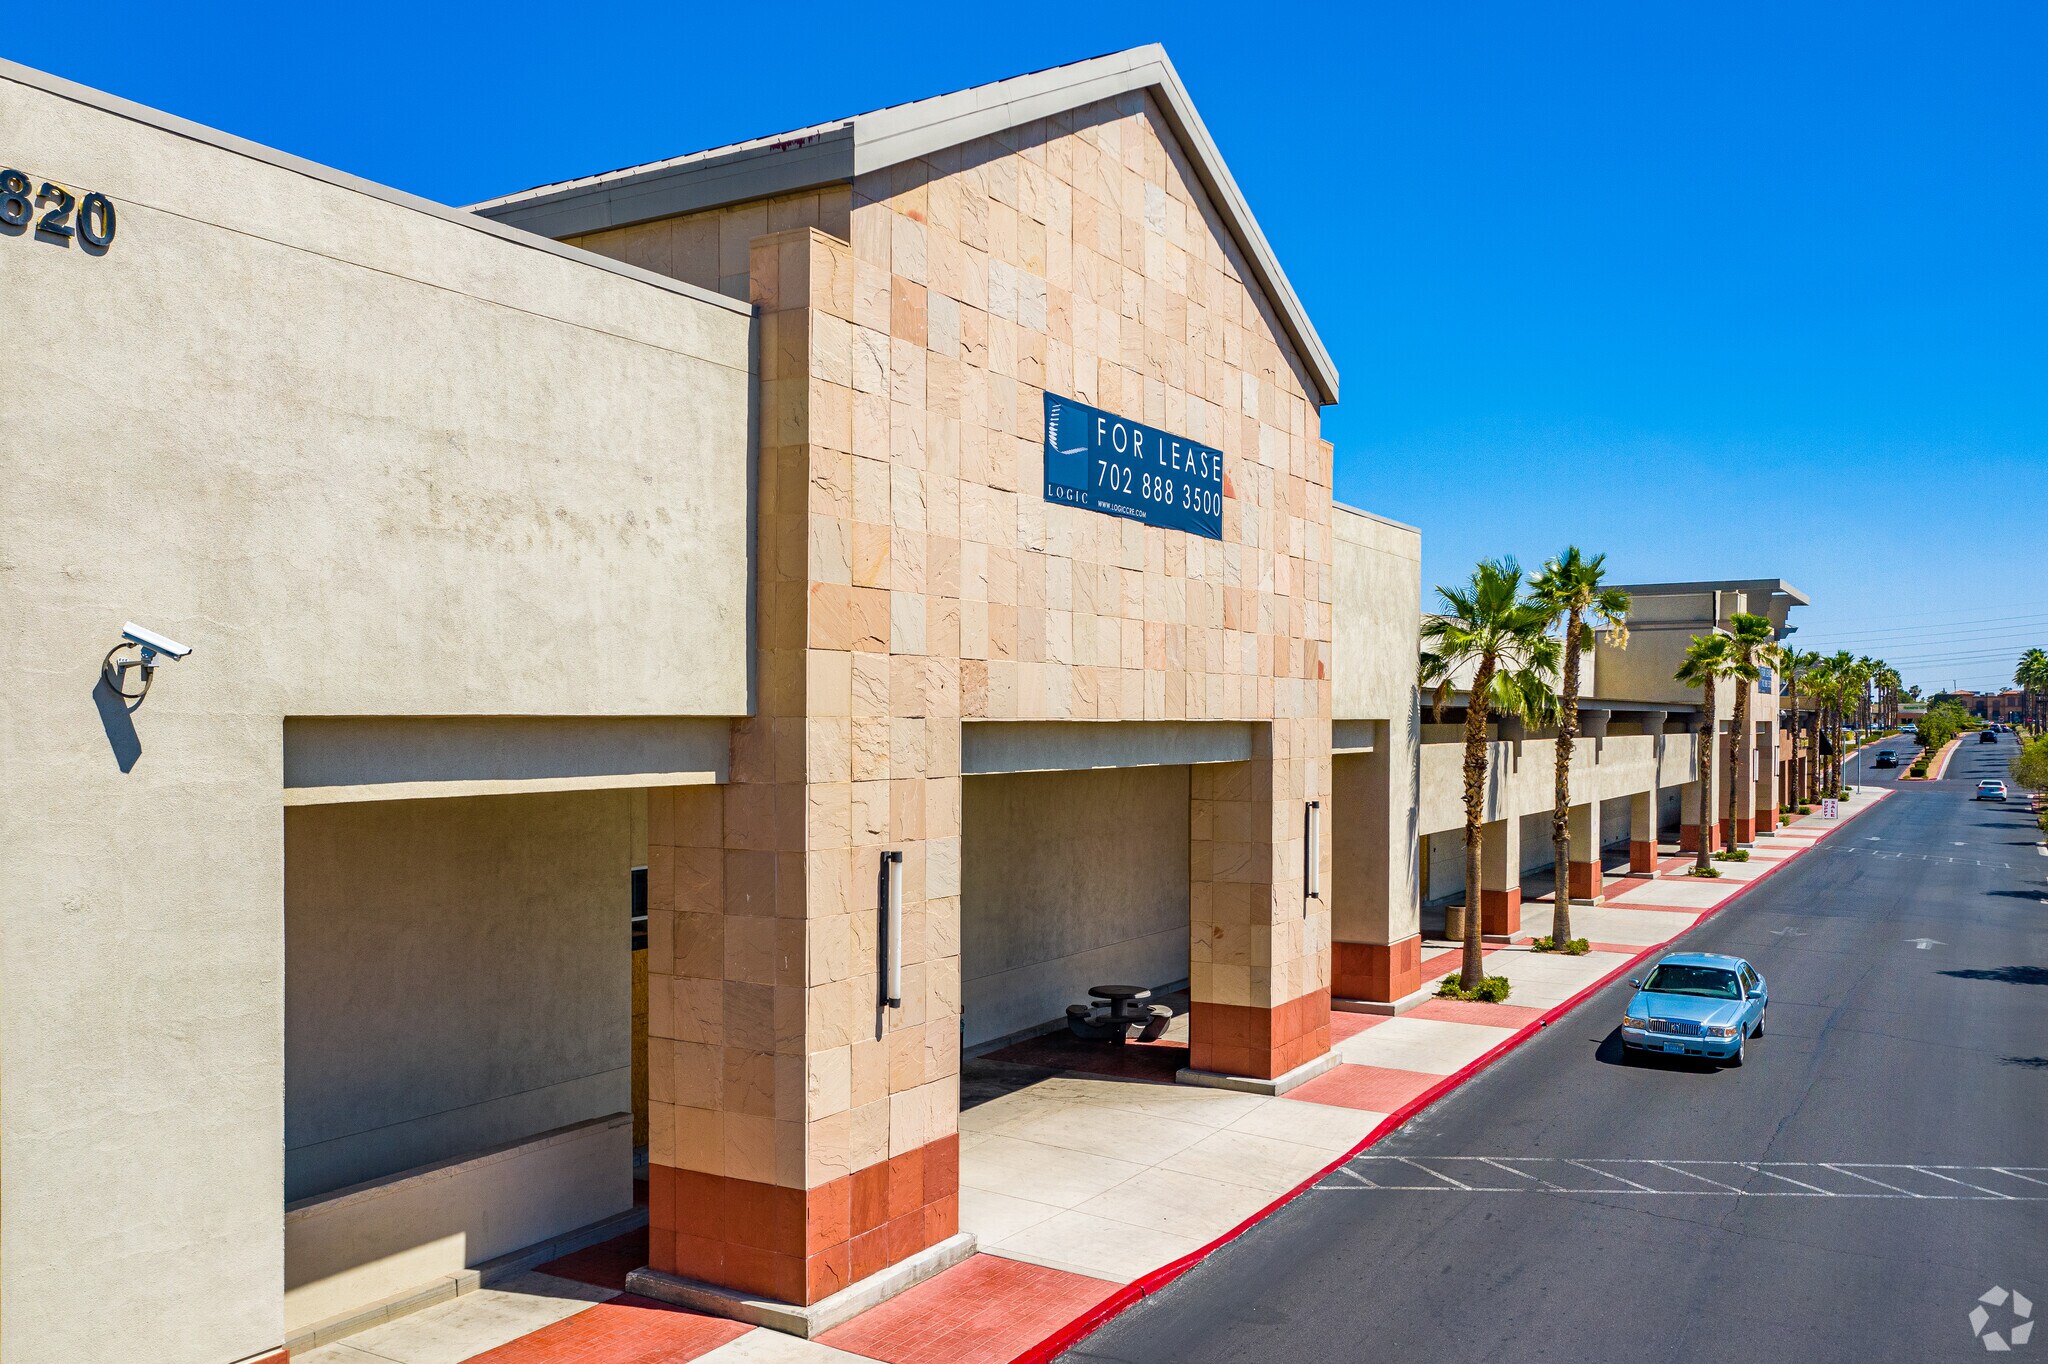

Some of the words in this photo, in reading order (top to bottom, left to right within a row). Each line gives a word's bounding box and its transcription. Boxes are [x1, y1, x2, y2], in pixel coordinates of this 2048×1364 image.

[0, 169, 117, 247] 820
[1097, 417, 1144, 459] FOR
[1159, 437, 1221, 483] LEASE
[1048, 484, 1088, 504] LOGIC
[1097, 500, 1147, 518] WWW.LOGICCRE.COM
[1098, 460, 1132, 494] 702
[1142, 472, 1174, 505] 888
[1182, 484, 1221, 517] 3500
